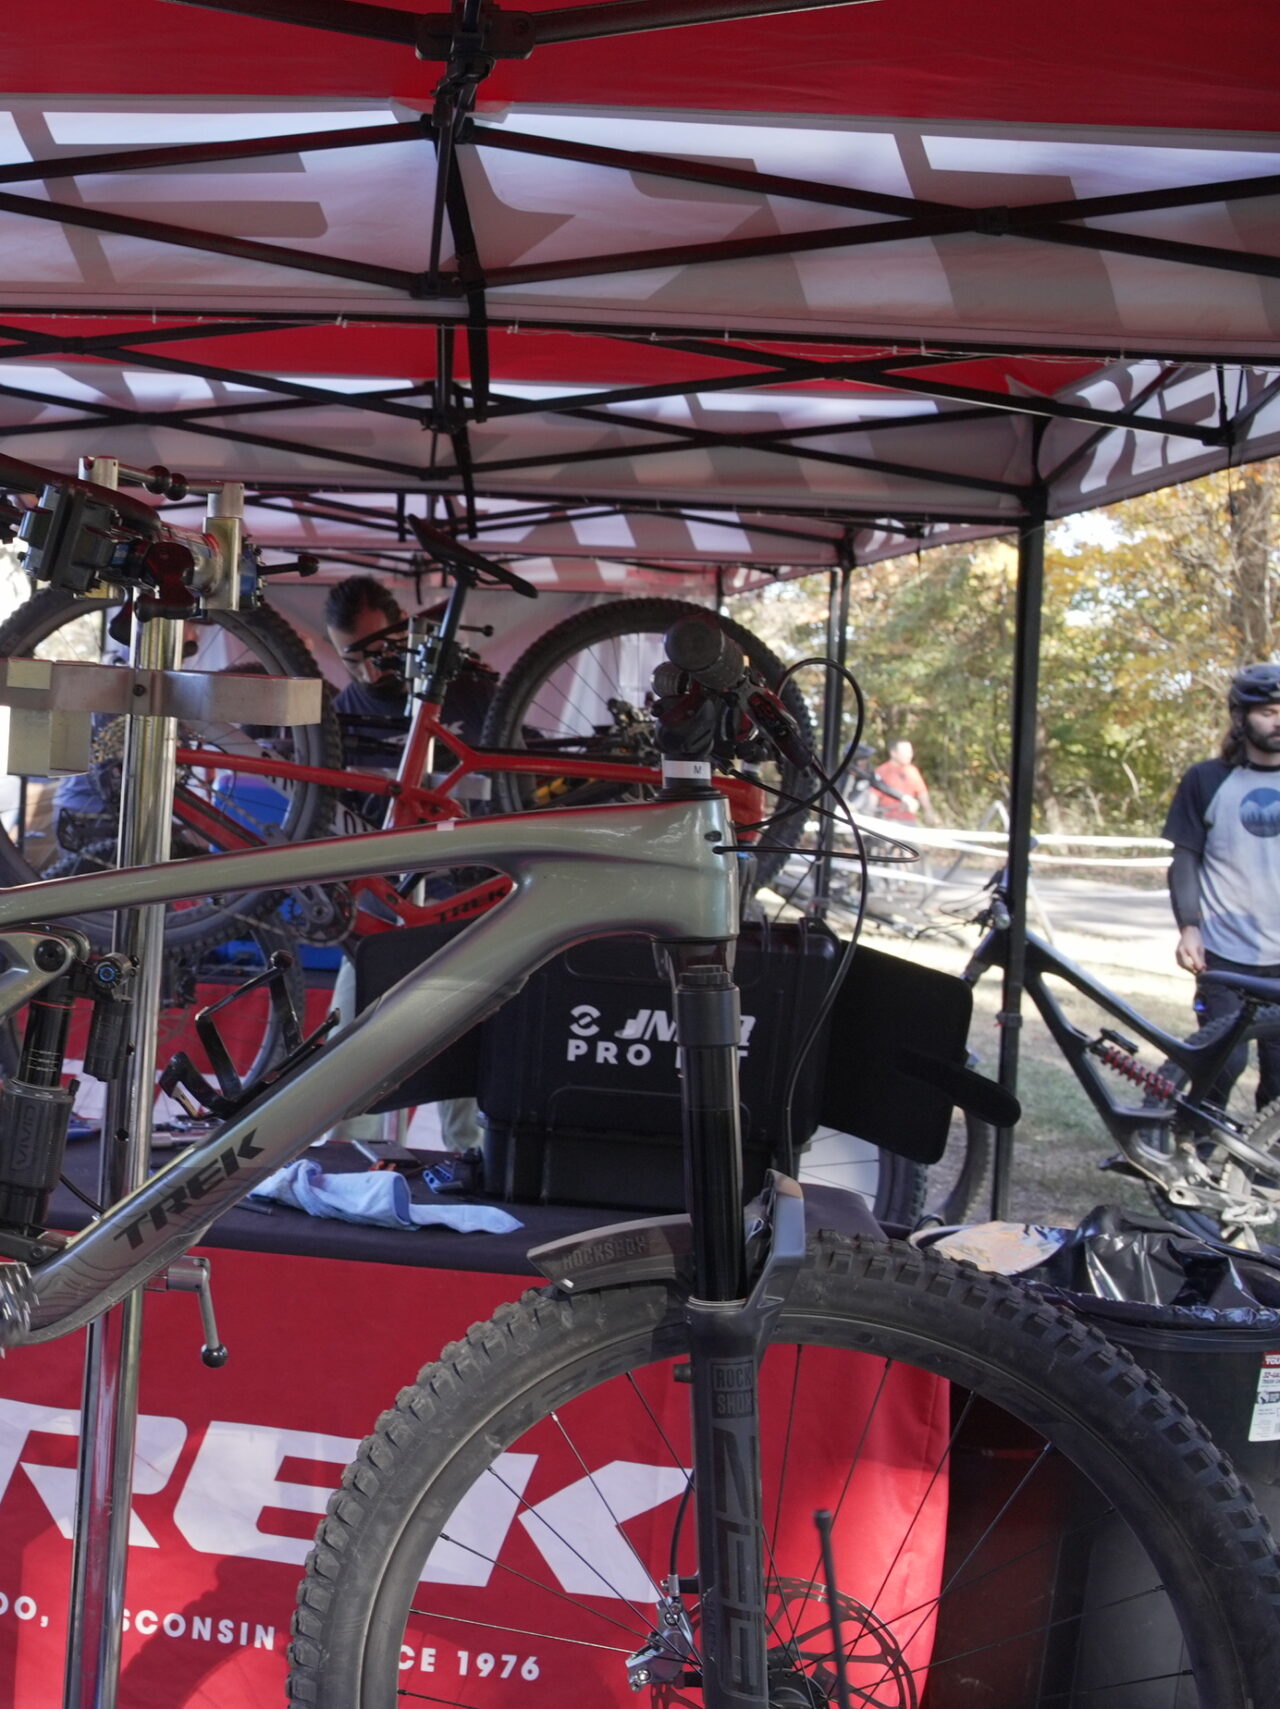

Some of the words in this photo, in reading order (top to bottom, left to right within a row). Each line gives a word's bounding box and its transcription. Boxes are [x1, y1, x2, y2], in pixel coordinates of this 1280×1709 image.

[567, 1039, 652, 1066] PRO
[113, 1127, 265, 1250] TREK
[716, 1366, 753, 1389] ROCK
[457, 1650, 540, 1682] 1976
